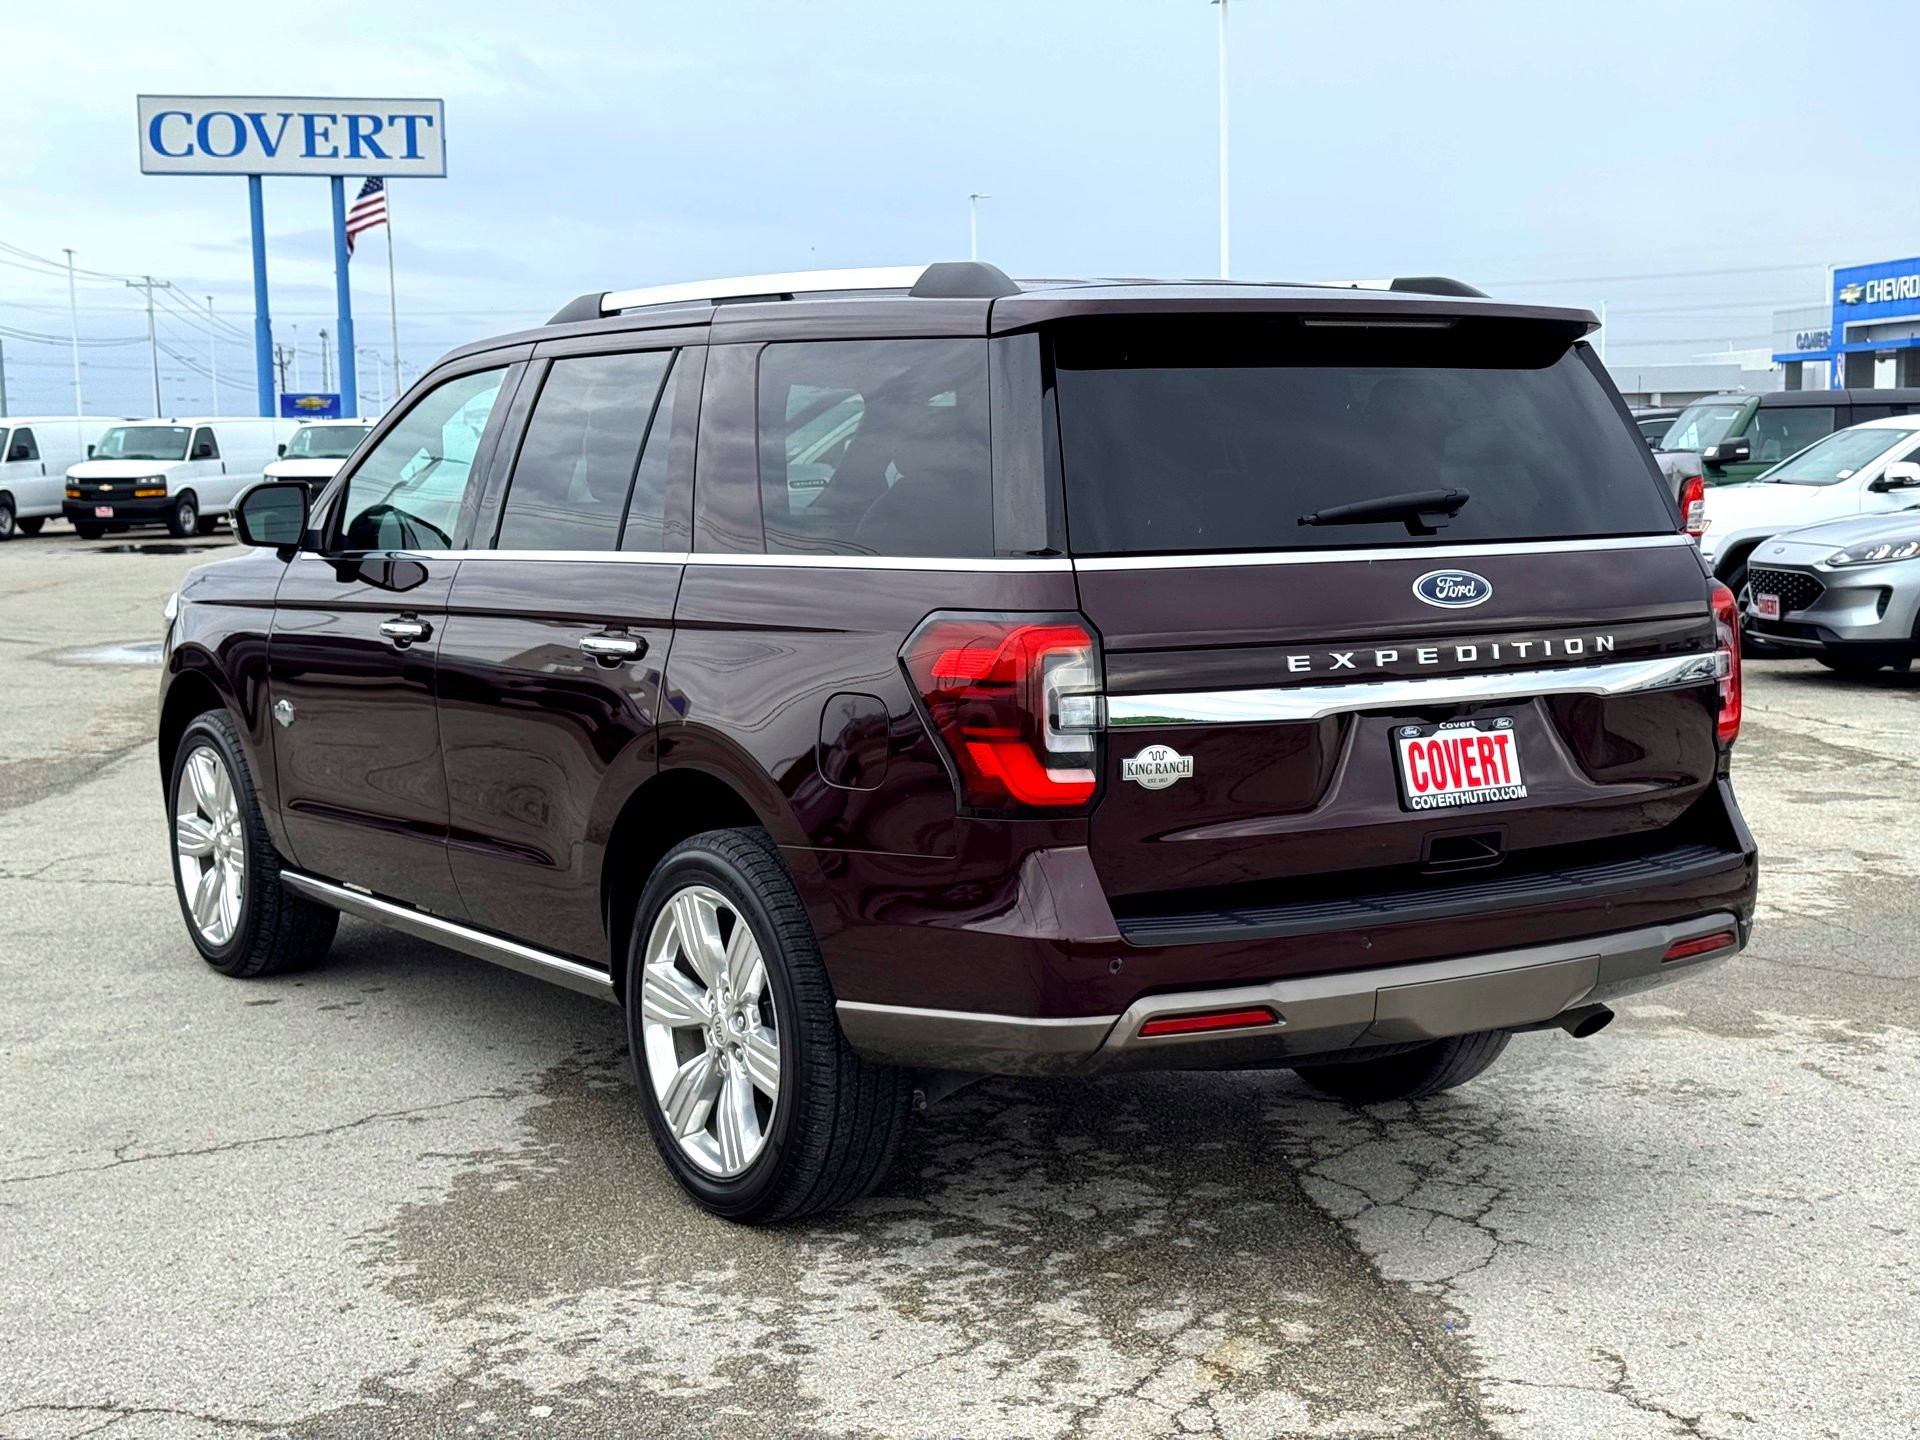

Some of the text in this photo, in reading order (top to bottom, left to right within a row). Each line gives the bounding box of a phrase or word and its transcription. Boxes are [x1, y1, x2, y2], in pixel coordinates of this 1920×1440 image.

[149, 110, 434, 160] COVERT
[1866, 274, 1920, 303] CHEVRO
[1435, 576, 1477, 599] Ford
[1286, 635, 1615, 673] EXPEDITION
[1439, 720, 1476, 730] Covert
[1127, 759, 1190, 776] KING RANCH
[1408, 734, 1511, 793] COVERT
[1411, 785, 1528, 810] COVERTHUTTO.COM
